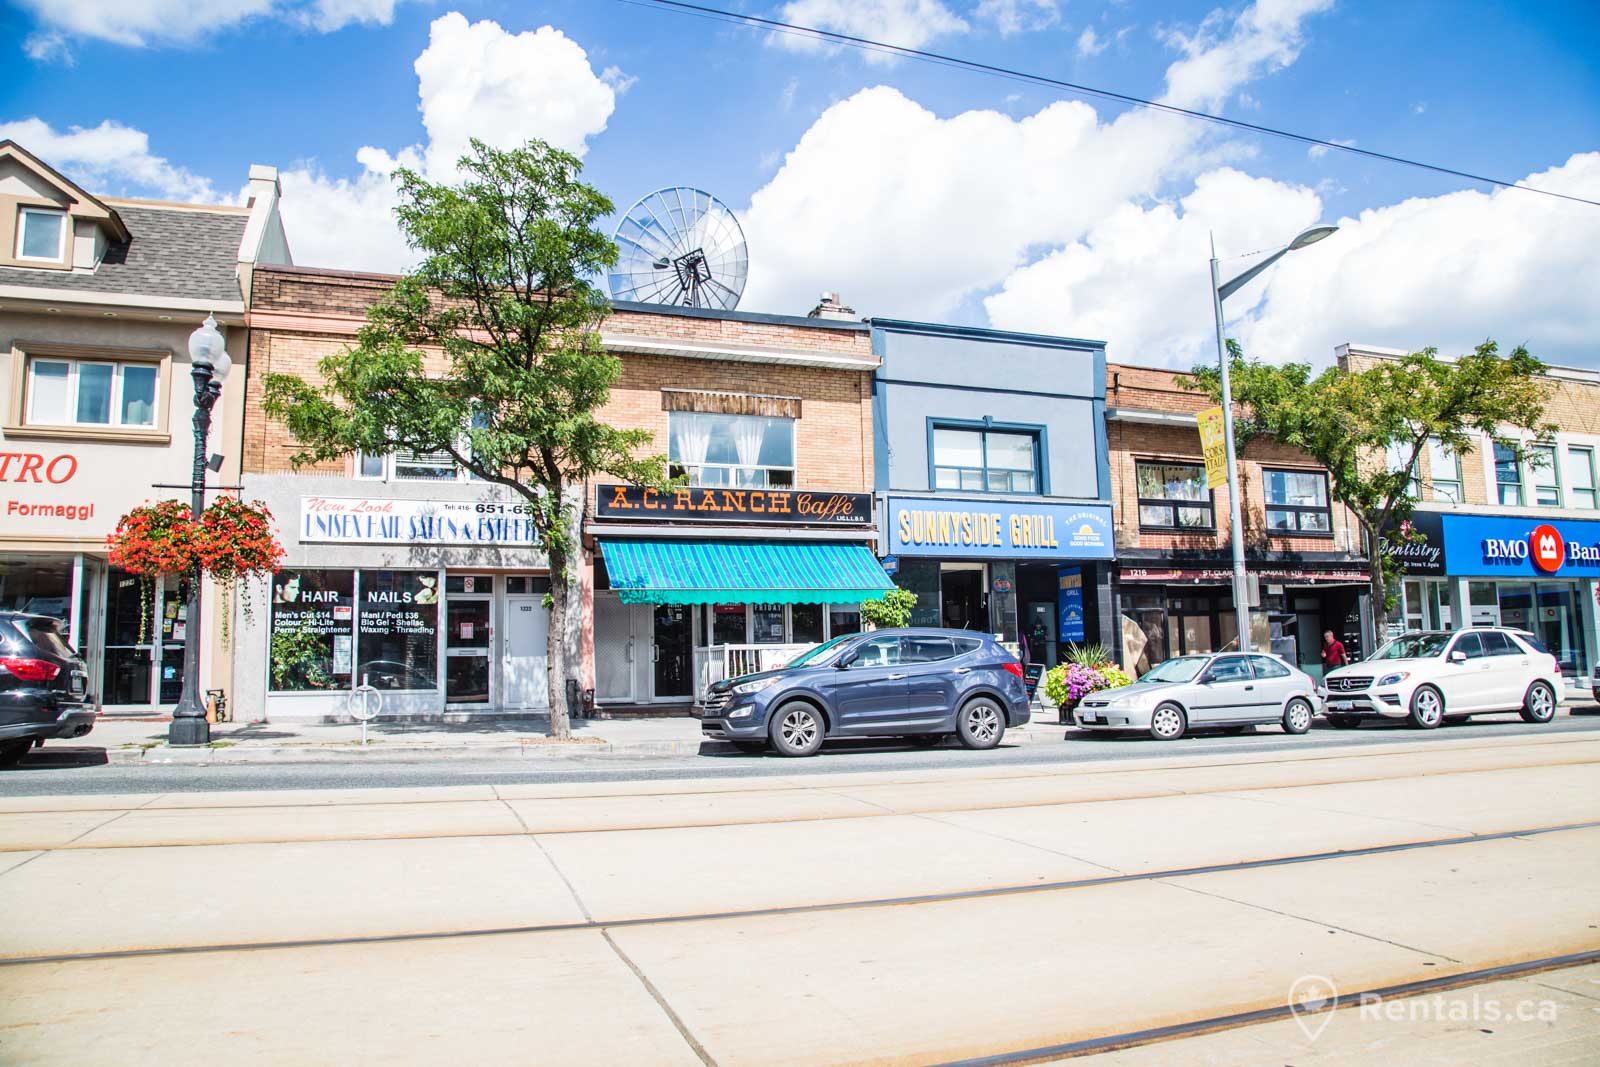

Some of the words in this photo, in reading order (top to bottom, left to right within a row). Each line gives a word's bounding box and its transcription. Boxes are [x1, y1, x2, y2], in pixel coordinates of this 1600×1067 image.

[307, 498, 345, 512] New
[350, 500, 394, 513] Look
[475, 503, 534, 515] 651-65
[673, 489, 791, 513] RANCH
[796, 493, 857, 521] Caffé
[306, 513, 362, 538] UNISEX
[367, 514, 404, 539] HAIR
[408, 515, 458, 540] SALON
[899, 510, 1003, 547] SUNNYSIDE
[1009, 514, 1058, 549] GRILL
[1378, 536, 1441, 562] Dentistry
[1486, 539, 1528, 558] BMO
[1569, 540, 1600, 560] Ban
[1130, 569, 1148, 577] 1216
[302, 590, 339, 603] HAIR
[368, 591, 412, 603] NAILS
[274, 611, 298, 619] Men's
[300, 611, 314, 619] Cut
[316, 611, 331, 619] $14
[302, 627, 351, 635] Straightener
[360, 627, 389, 635] Waxing
[396, 627, 435, 635] Threading
